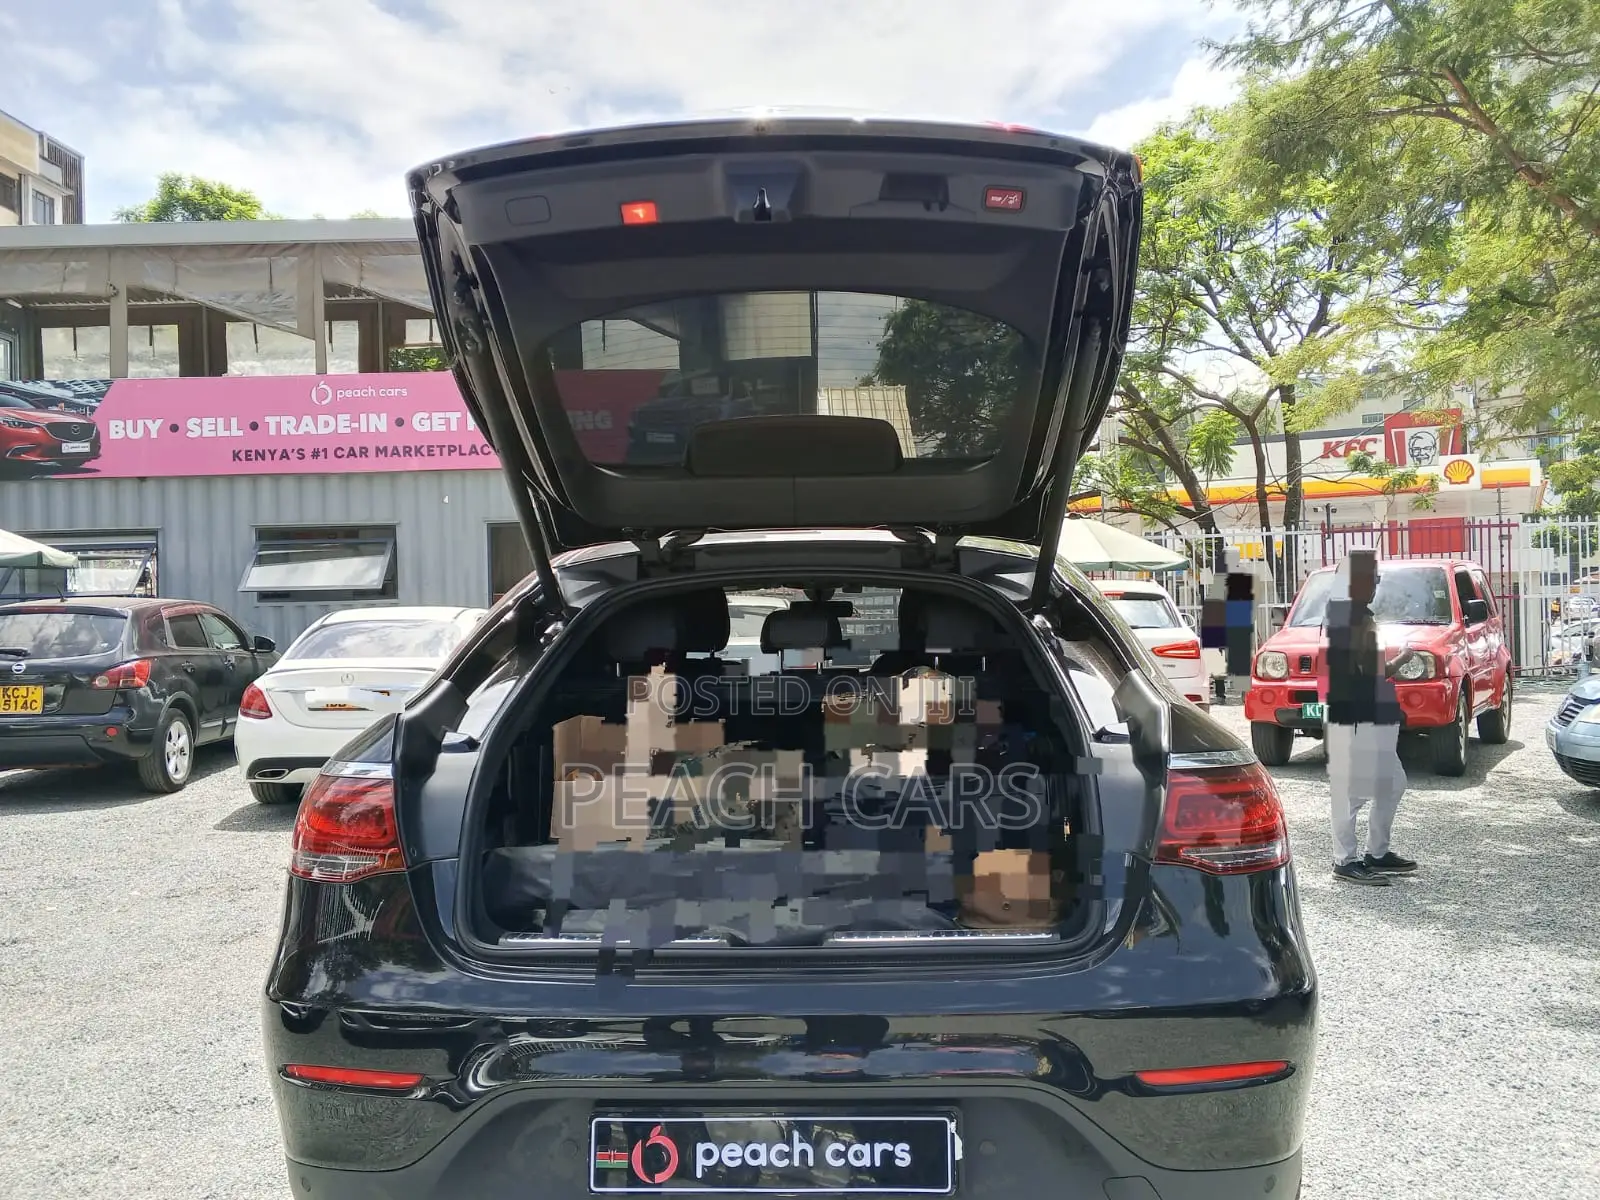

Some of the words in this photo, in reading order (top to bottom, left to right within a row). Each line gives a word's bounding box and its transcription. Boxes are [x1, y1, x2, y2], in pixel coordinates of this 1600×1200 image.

[336, 386, 376, 401] peach
[378, 387, 408, 397] cars
[108, 418, 164, 440] BUY
[185, 416, 244, 438] SELL
[264, 415, 387, 435] TRADE-IN
[411, 411, 461, 432] GET
[232, 447, 306, 462] KENYA'S
[311, 447, 328, 459] #1
[333, 446, 369, 459] CAR
[375, 443, 498, 458] MARKETPLAC
[1321, 438, 1377, 459] KFC
[2, 687, 30, 699] KCJ
[2, 699, 38, 711] 514C
[696, 1130, 814, 1178] peach
[825, 1140, 911, 1167] cars
